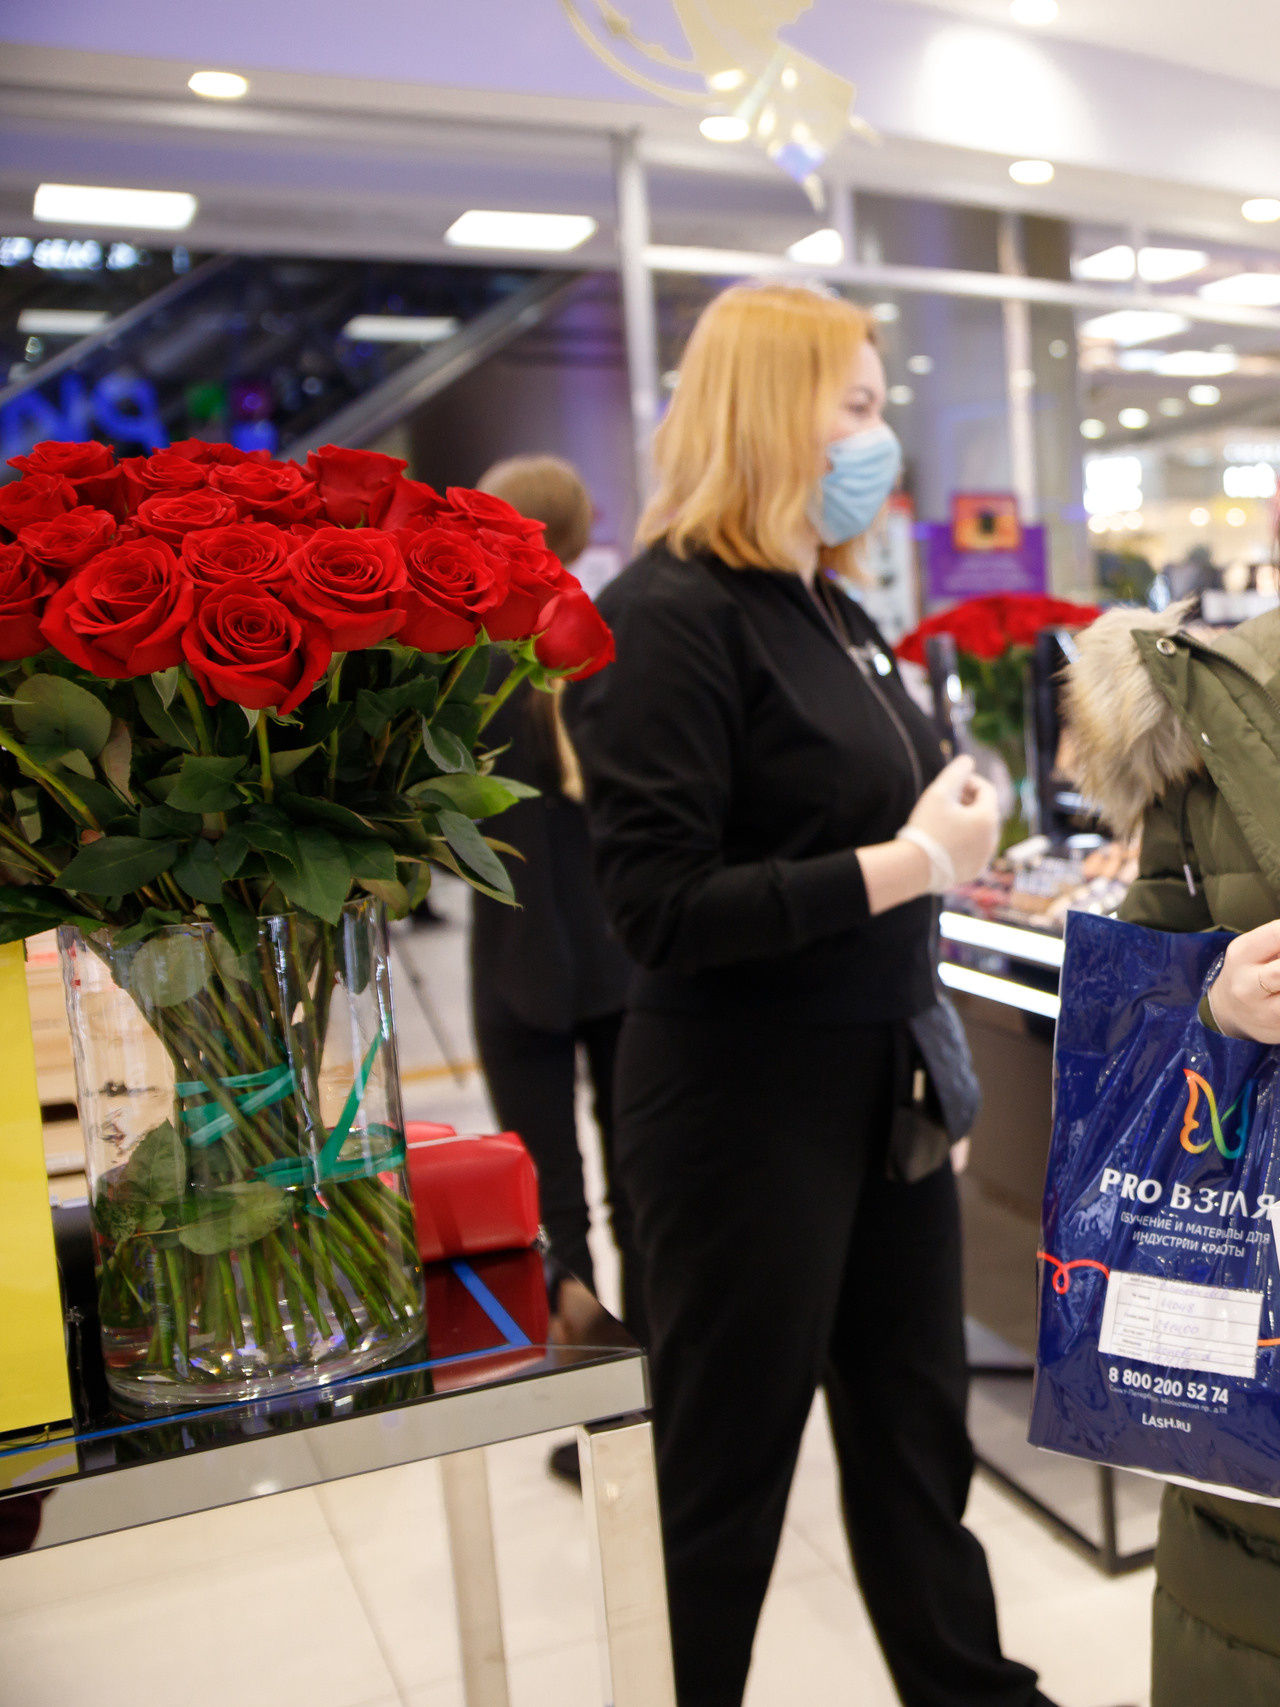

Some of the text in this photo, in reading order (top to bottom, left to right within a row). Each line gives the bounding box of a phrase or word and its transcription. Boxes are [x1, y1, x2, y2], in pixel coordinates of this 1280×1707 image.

[1099, 1168, 1277, 1221] PRO ВЗГЛЯ
[1132, 1230, 1199, 1251] ИНДУСТРИИ
[1174, 1221, 1183, 1231] И
[1245, 1231, 1271, 1244] ДЛЯ
[1108, 1366, 1229, 1405] 8 800 200 52 74
[1141, 1413, 1191, 1433] LASH.RU
